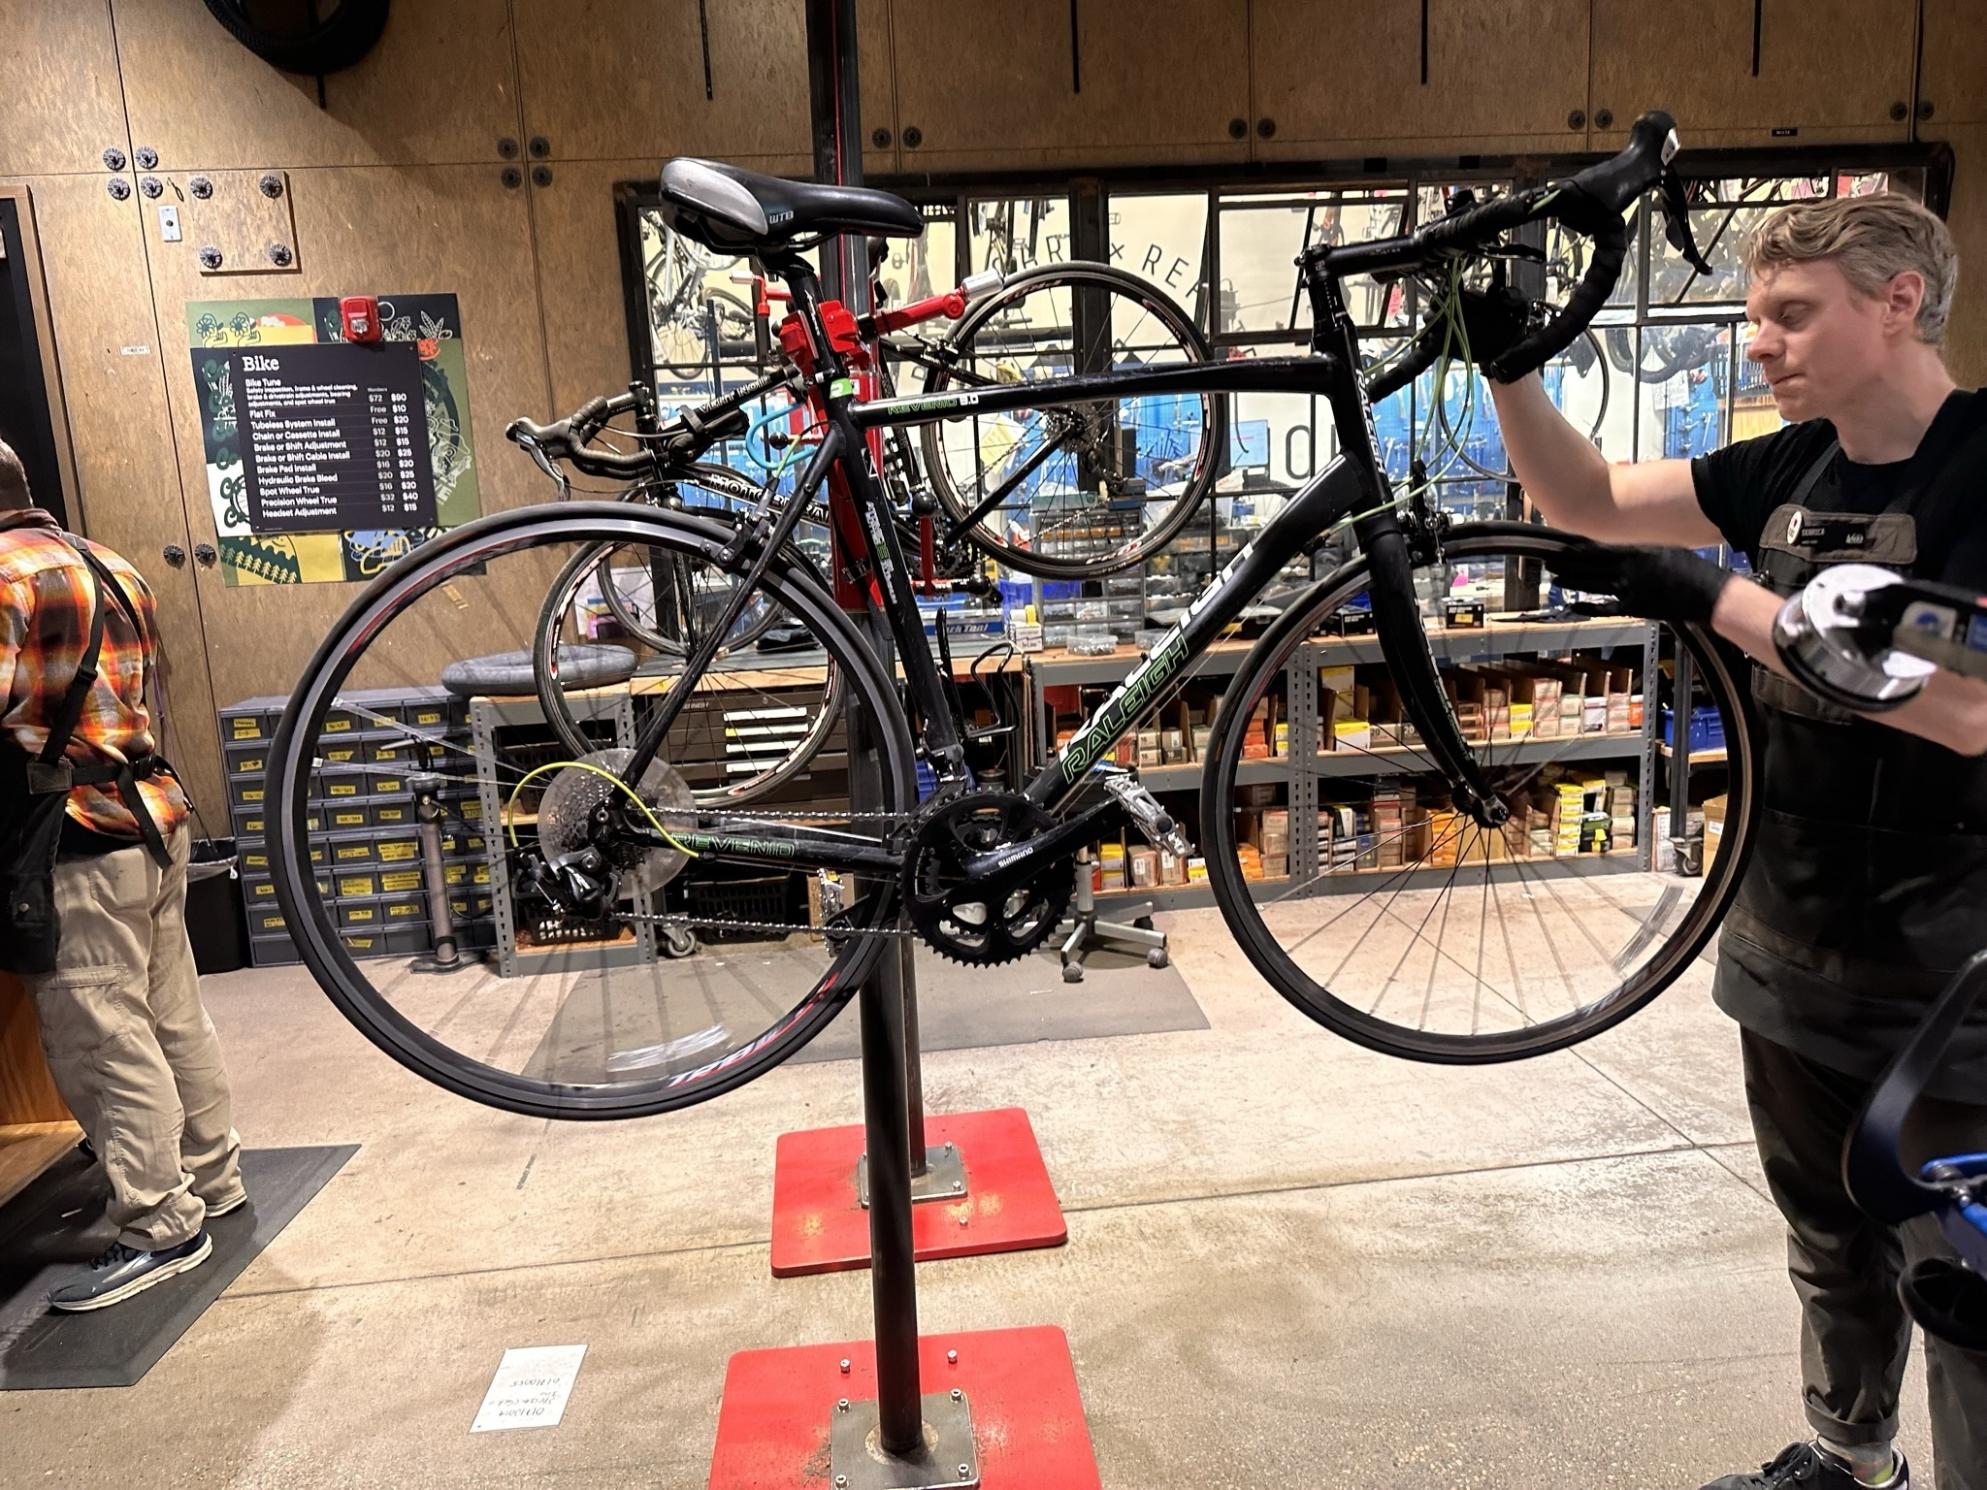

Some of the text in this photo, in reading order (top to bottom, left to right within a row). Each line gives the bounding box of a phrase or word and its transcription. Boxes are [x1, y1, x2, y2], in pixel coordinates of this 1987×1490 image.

[769, 210, 794, 224] WTB
[242, 355, 279, 371] Bike
[245, 378, 281, 387] Bike Tune
[369, 394, 382, 402] $72
[393, 404, 406, 413] $10
[249, 410, 276, 418] Flat Fix
[251, 418, 336, 430] Tubeless System Install
[394, 415, 409, 424] $20
[1355, 368, 1387, 474] RALEIGH
[252, 432, 274, 440] Chain
[285, 431, 317, 439] Cassette
[318, 429, 340, 438] Install
[373, 427, 408, 436] $12 $15
[254, 443, 275, 452] Brake
[286, 442, 303, 450] Shift
[304, 441, 346, 450] Adjustment
[374, 438, 409, 447] $12 $15
[255, 454, 276, 463] Brake
[287, 453, 304, 461] Shift
[328, 451, 350, 459] Install
[375, 448, 412, 458] $20 $25
[257, 463, 316, 474] Brake Pad Install
[377, 459, 414, 469] $16 $20
[378, 470, 414, 479] $20 $25
[258, 476, 293, 486] Hydraulic
[317, 474, 338, 482] Bleed
[379, 481, 416, 490] $16 $20
[260, 488, 278, 497] Spot
[278, 486, 302, 495] Wheel
[381, 492, 418, 501] $32 $40
[261, 499, 295, 507] Precision
[296, 497, 319, 505] Wheel
[263, 507, 336, 518] Headset Adjustment
[382, 503, 417, 512] $12 $15
[963, 623, 989, 633] Tool
[1061, 633, 1190, 785] RALEIGH
[671, 832, 795, 857] REVENIO
[998, 846, 1034, 868] SHIMANO
